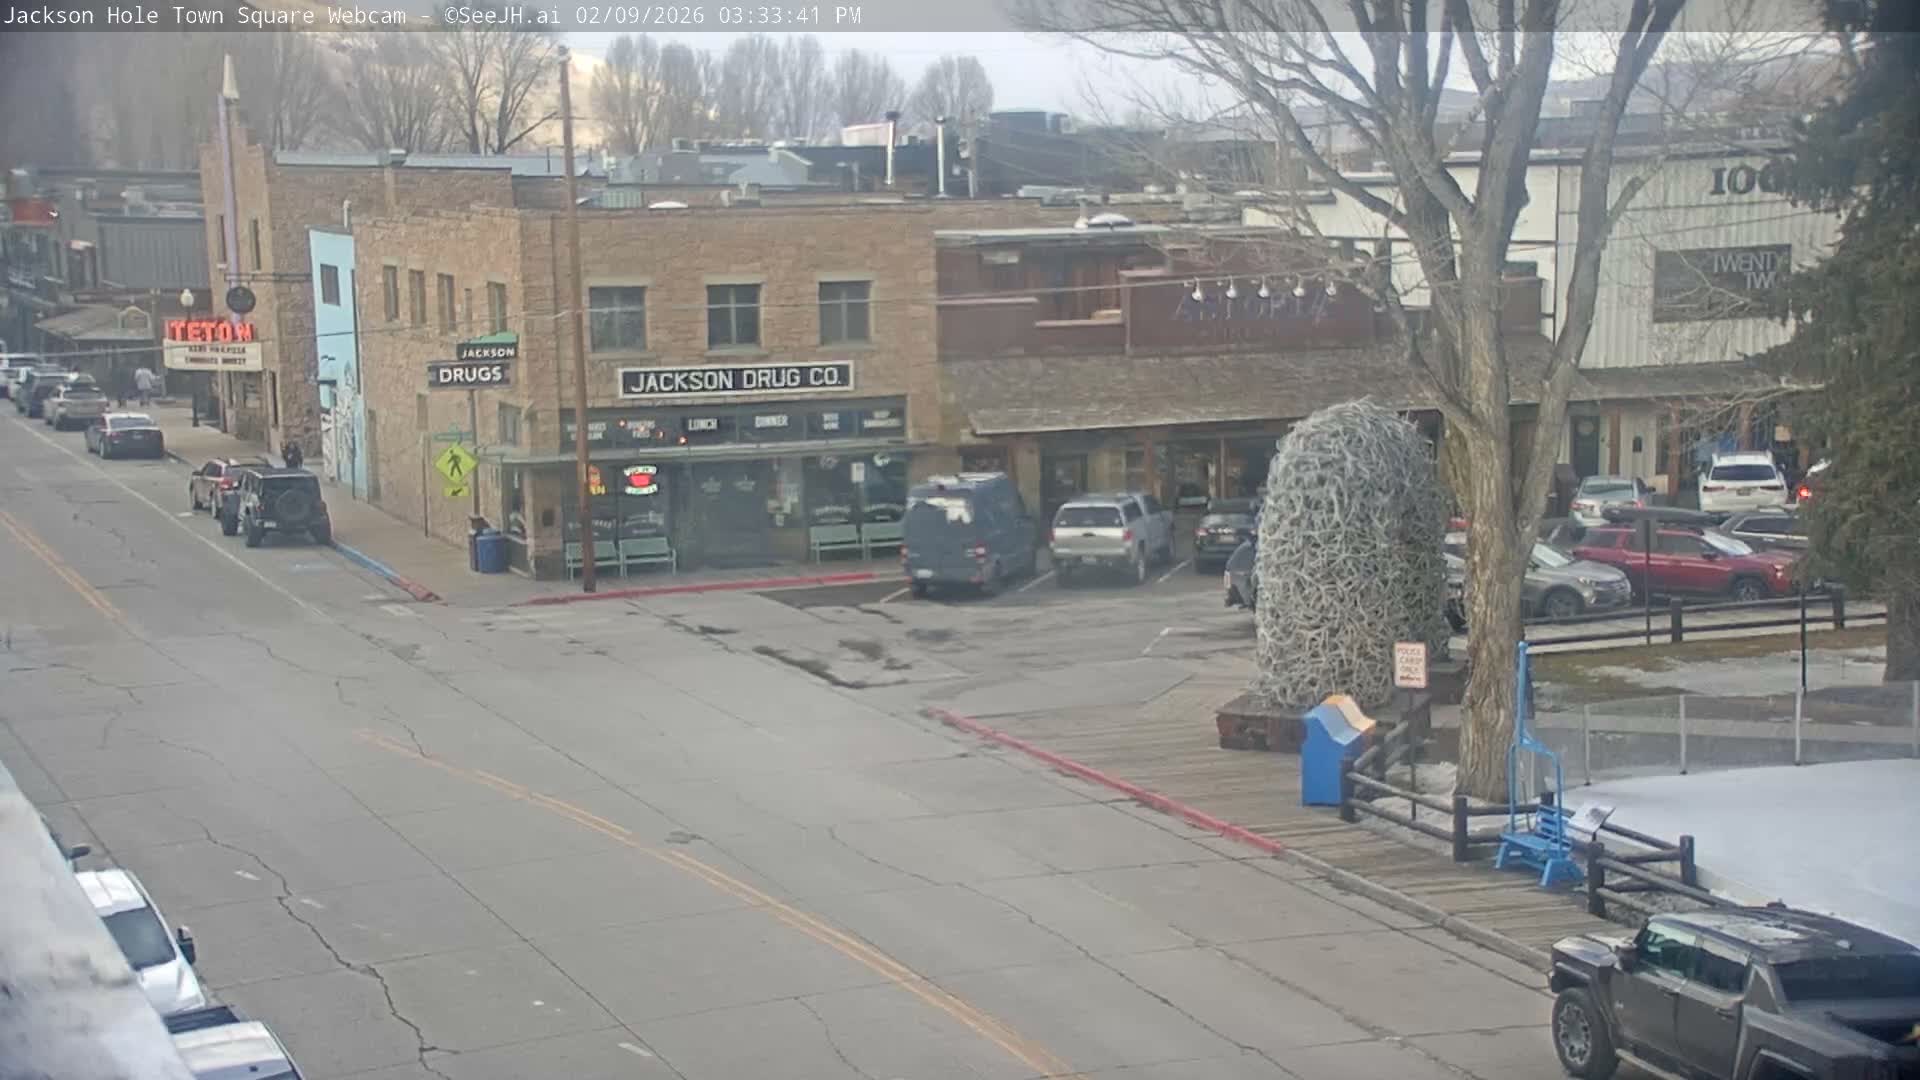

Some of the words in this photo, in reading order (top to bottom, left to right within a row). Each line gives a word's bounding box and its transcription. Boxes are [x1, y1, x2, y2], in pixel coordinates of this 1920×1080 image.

[170, 320, 253, 343] TETON
[461, 347, 516, 359] JACKSON
[439, 365, 503, 383] DRUGS
[631, 370, 733, 393] JACKSON
[743, 367, 801, 389] DRUG
[809, 367, 843, 386] CO.
[687, 418, 718, 431] LUNCH
[754, 415, 789, 429] DINNER
